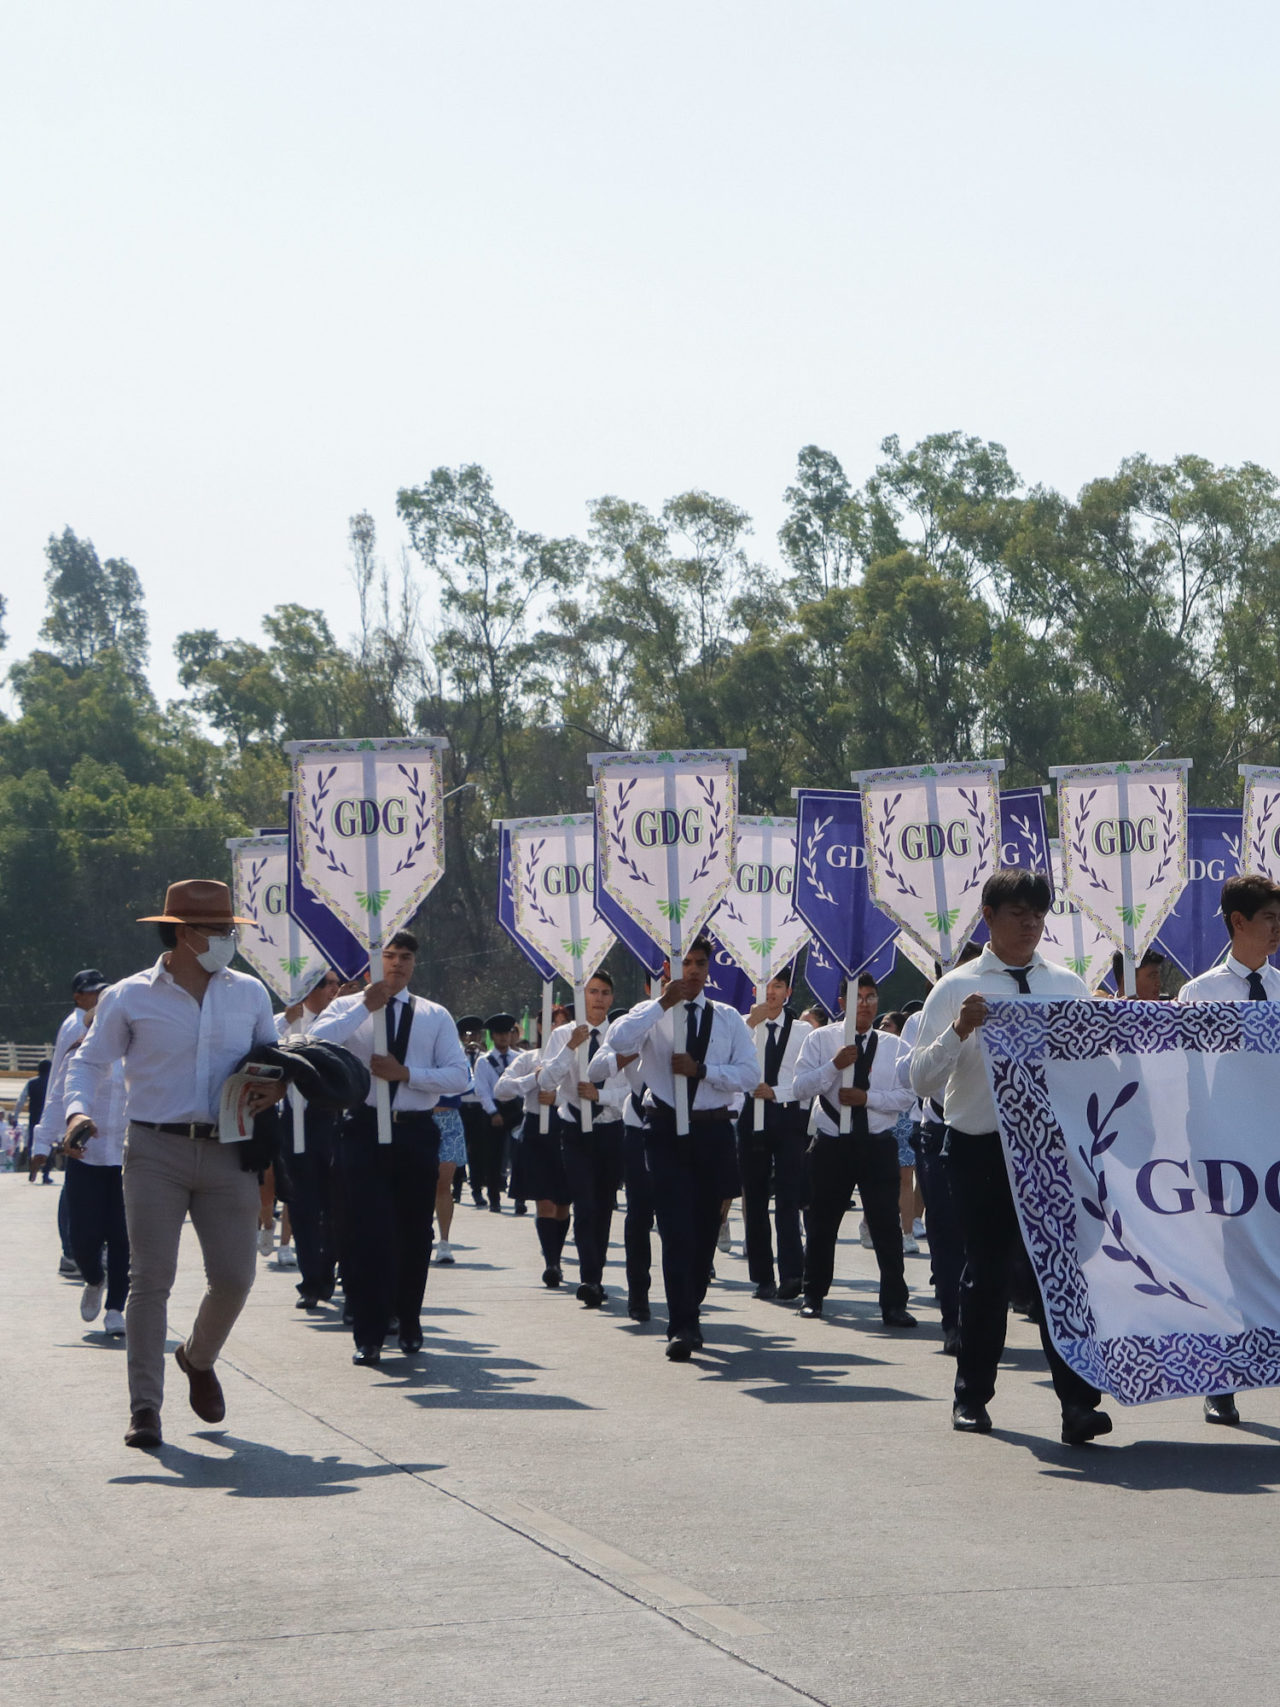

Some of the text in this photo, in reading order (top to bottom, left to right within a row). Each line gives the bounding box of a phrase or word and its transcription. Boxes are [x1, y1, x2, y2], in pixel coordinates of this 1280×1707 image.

[334, 798, 406, 838] GDG
[634, 807, 702, 847] GDG
[1094, 817, 1156, 856] GDG
[900, 821, 970, 861] GDG
[736, 863, 793, 895] GDG
